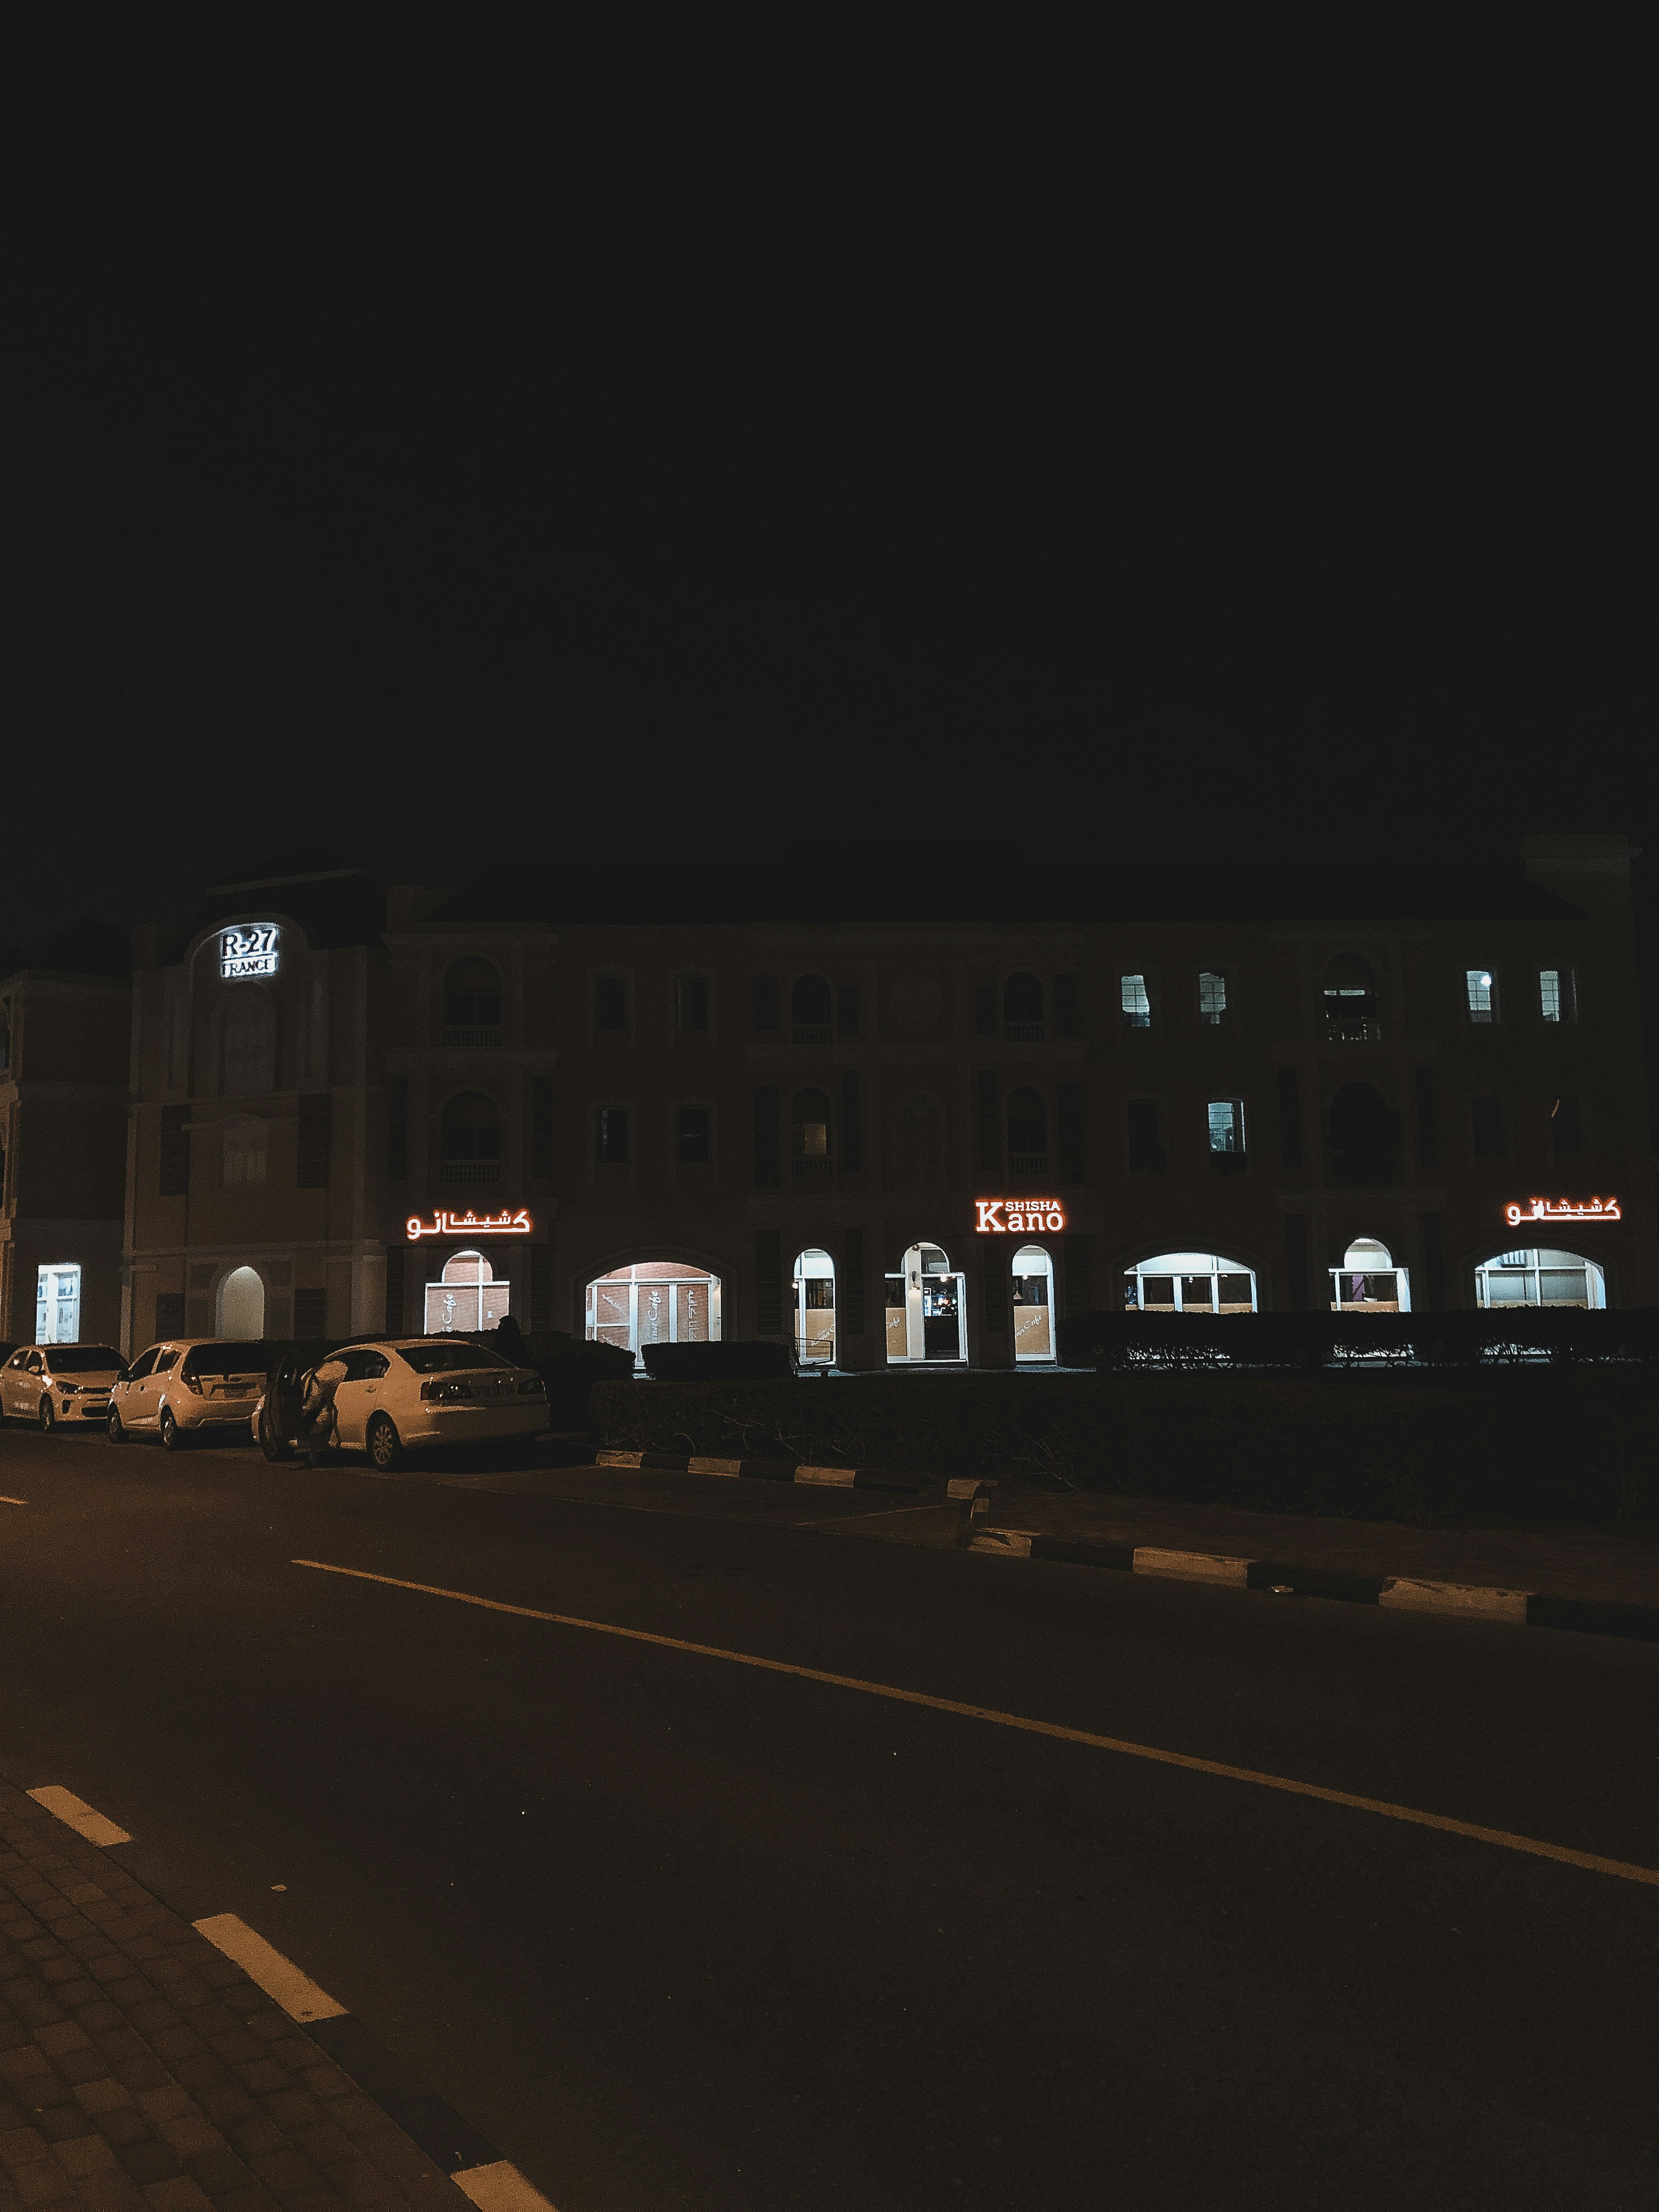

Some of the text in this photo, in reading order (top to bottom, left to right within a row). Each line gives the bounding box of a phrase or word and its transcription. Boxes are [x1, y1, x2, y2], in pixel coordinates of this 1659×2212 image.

[222, 929, 274, 957] R-27
[222, 958, 273, 975] FRANCE
[975, 1201, 1063, 1232] Kano
[1005, 1201, 1061, 1212] SHISHA
